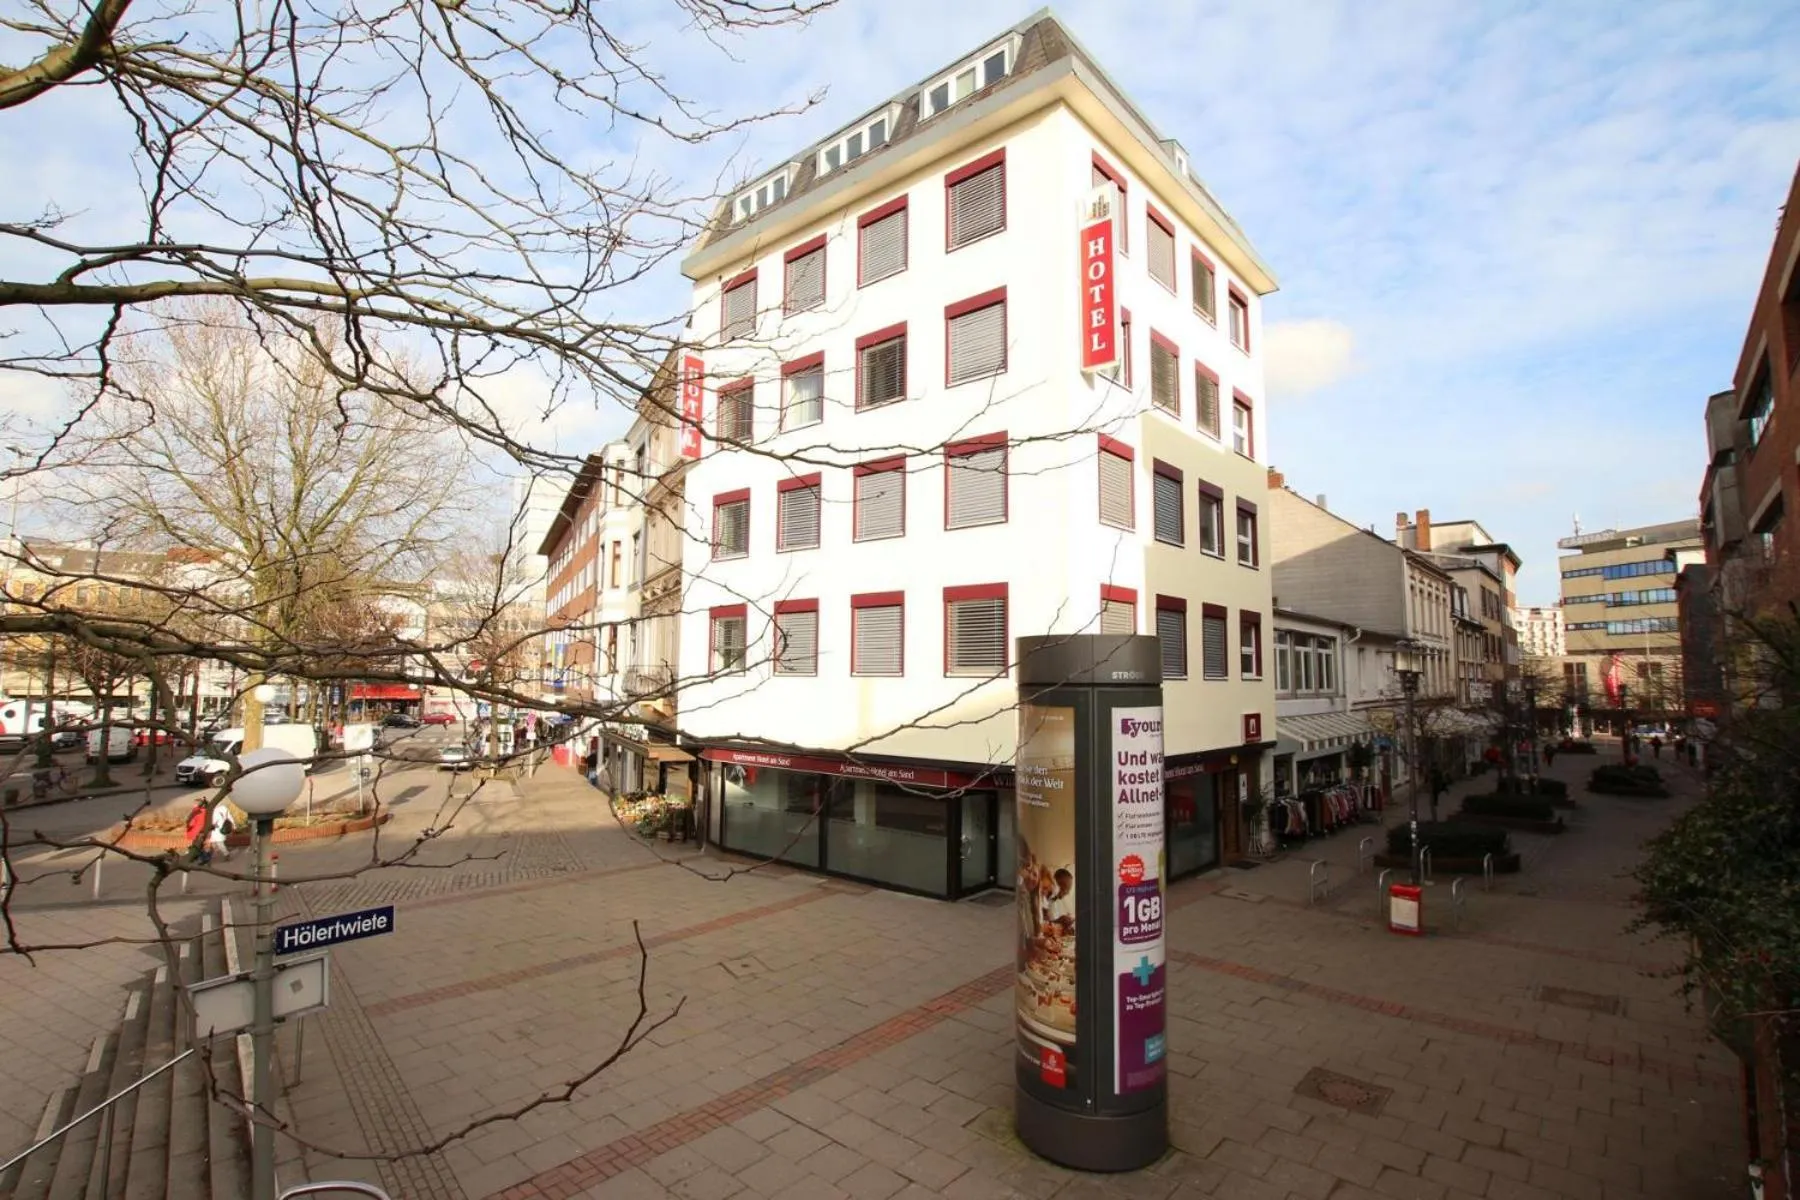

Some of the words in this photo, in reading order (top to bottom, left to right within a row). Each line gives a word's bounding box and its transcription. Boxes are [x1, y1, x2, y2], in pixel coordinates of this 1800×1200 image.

[1088, 237, 1106, 352] HOTEL
[685, 366, 700, 449] HOTL
[1117, 750, 1147, 766] Und
[898, 768, 915, 780] Sand
[1117, 769, 1160, 785] kostet
[1044, 776, 1064, 789] Welt
[283, 913, 387, 949] Hölertwiete
[1123, 925, 1140, 937] pro
